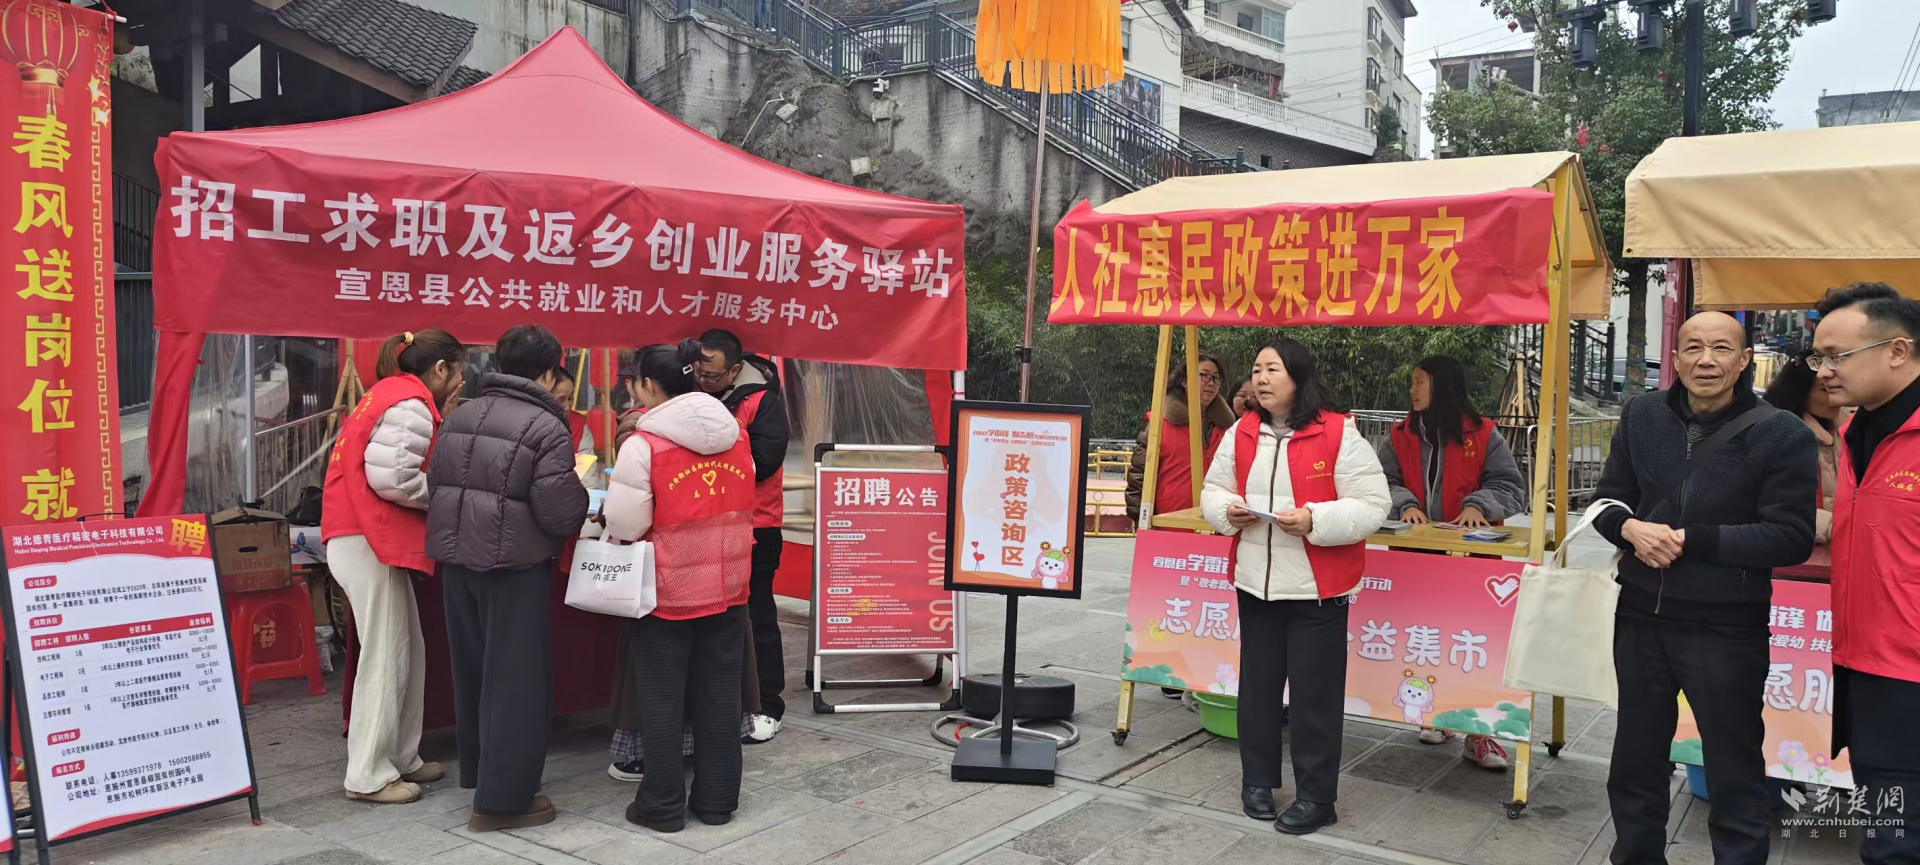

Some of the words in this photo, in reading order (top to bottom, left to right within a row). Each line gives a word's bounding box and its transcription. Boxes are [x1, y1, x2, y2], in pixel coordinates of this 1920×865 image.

[170, 174, 953, 299] 招工求职及返乡创业服务驿站
[12, 113, 76, 434] 春风送岗位
[1050, 206, 1465, 319] 人社惠民政策进万家
[334, 266, 840, 331] 宣恩县公共就业和人才服务中心
[21, 467, 79, 521] 就
[833, 476, 939, 507] 招聘公告
[1001, 453, 1031, 567] 政策咨询区
[12, 525, 163, 547] 湖北德青医疗精密电子科技有限公司
[49, 544, 69, 552] Medical
[169, 518, 207, 556] 聘
[28, 578, 52, 588] 公司简介
[1361, 577, 1392, 591] 行动
[33, 617, 58, 627] 招聘岗位
[1159, 597, 1241, 641] 志愿
[1347, 619, 1488, 673] 益集市
[34, 637, 59, 648] 招聘工种
[65, 632, 90, 643] 招聘人数
[1769, 634, 1805, 649] 爱幼
[56, 763, 81, 775] 报名方式
